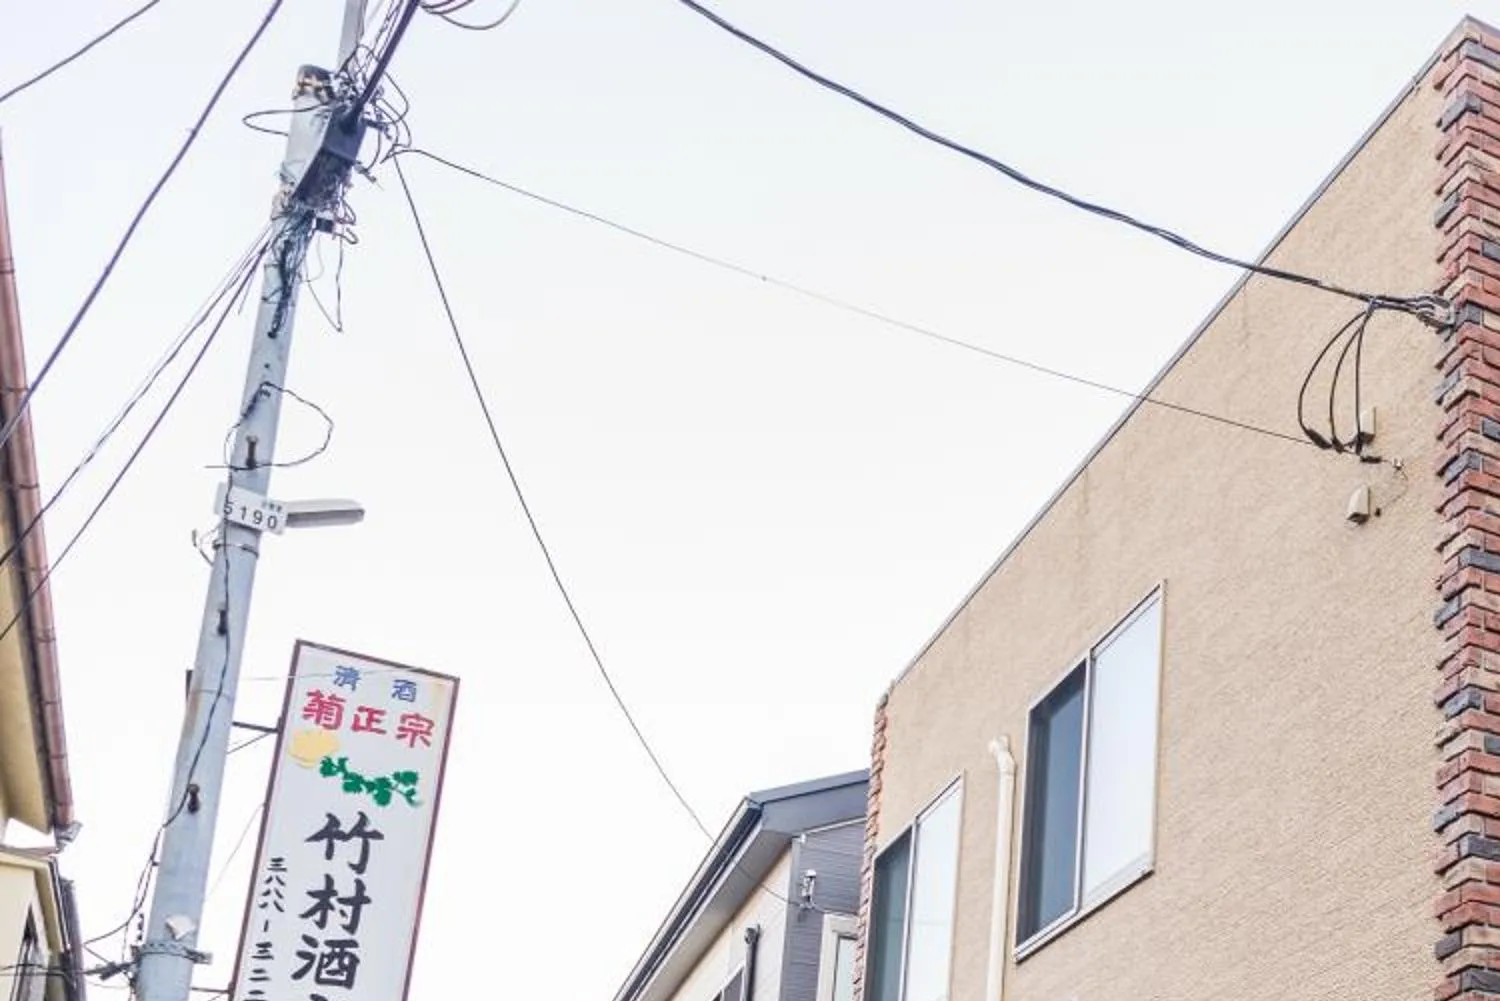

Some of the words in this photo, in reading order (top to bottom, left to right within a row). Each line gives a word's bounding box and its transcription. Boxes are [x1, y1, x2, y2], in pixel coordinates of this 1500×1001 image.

[223, 501, 278, 529] 5190
[303, 689, 435, 748] 菊正宗
